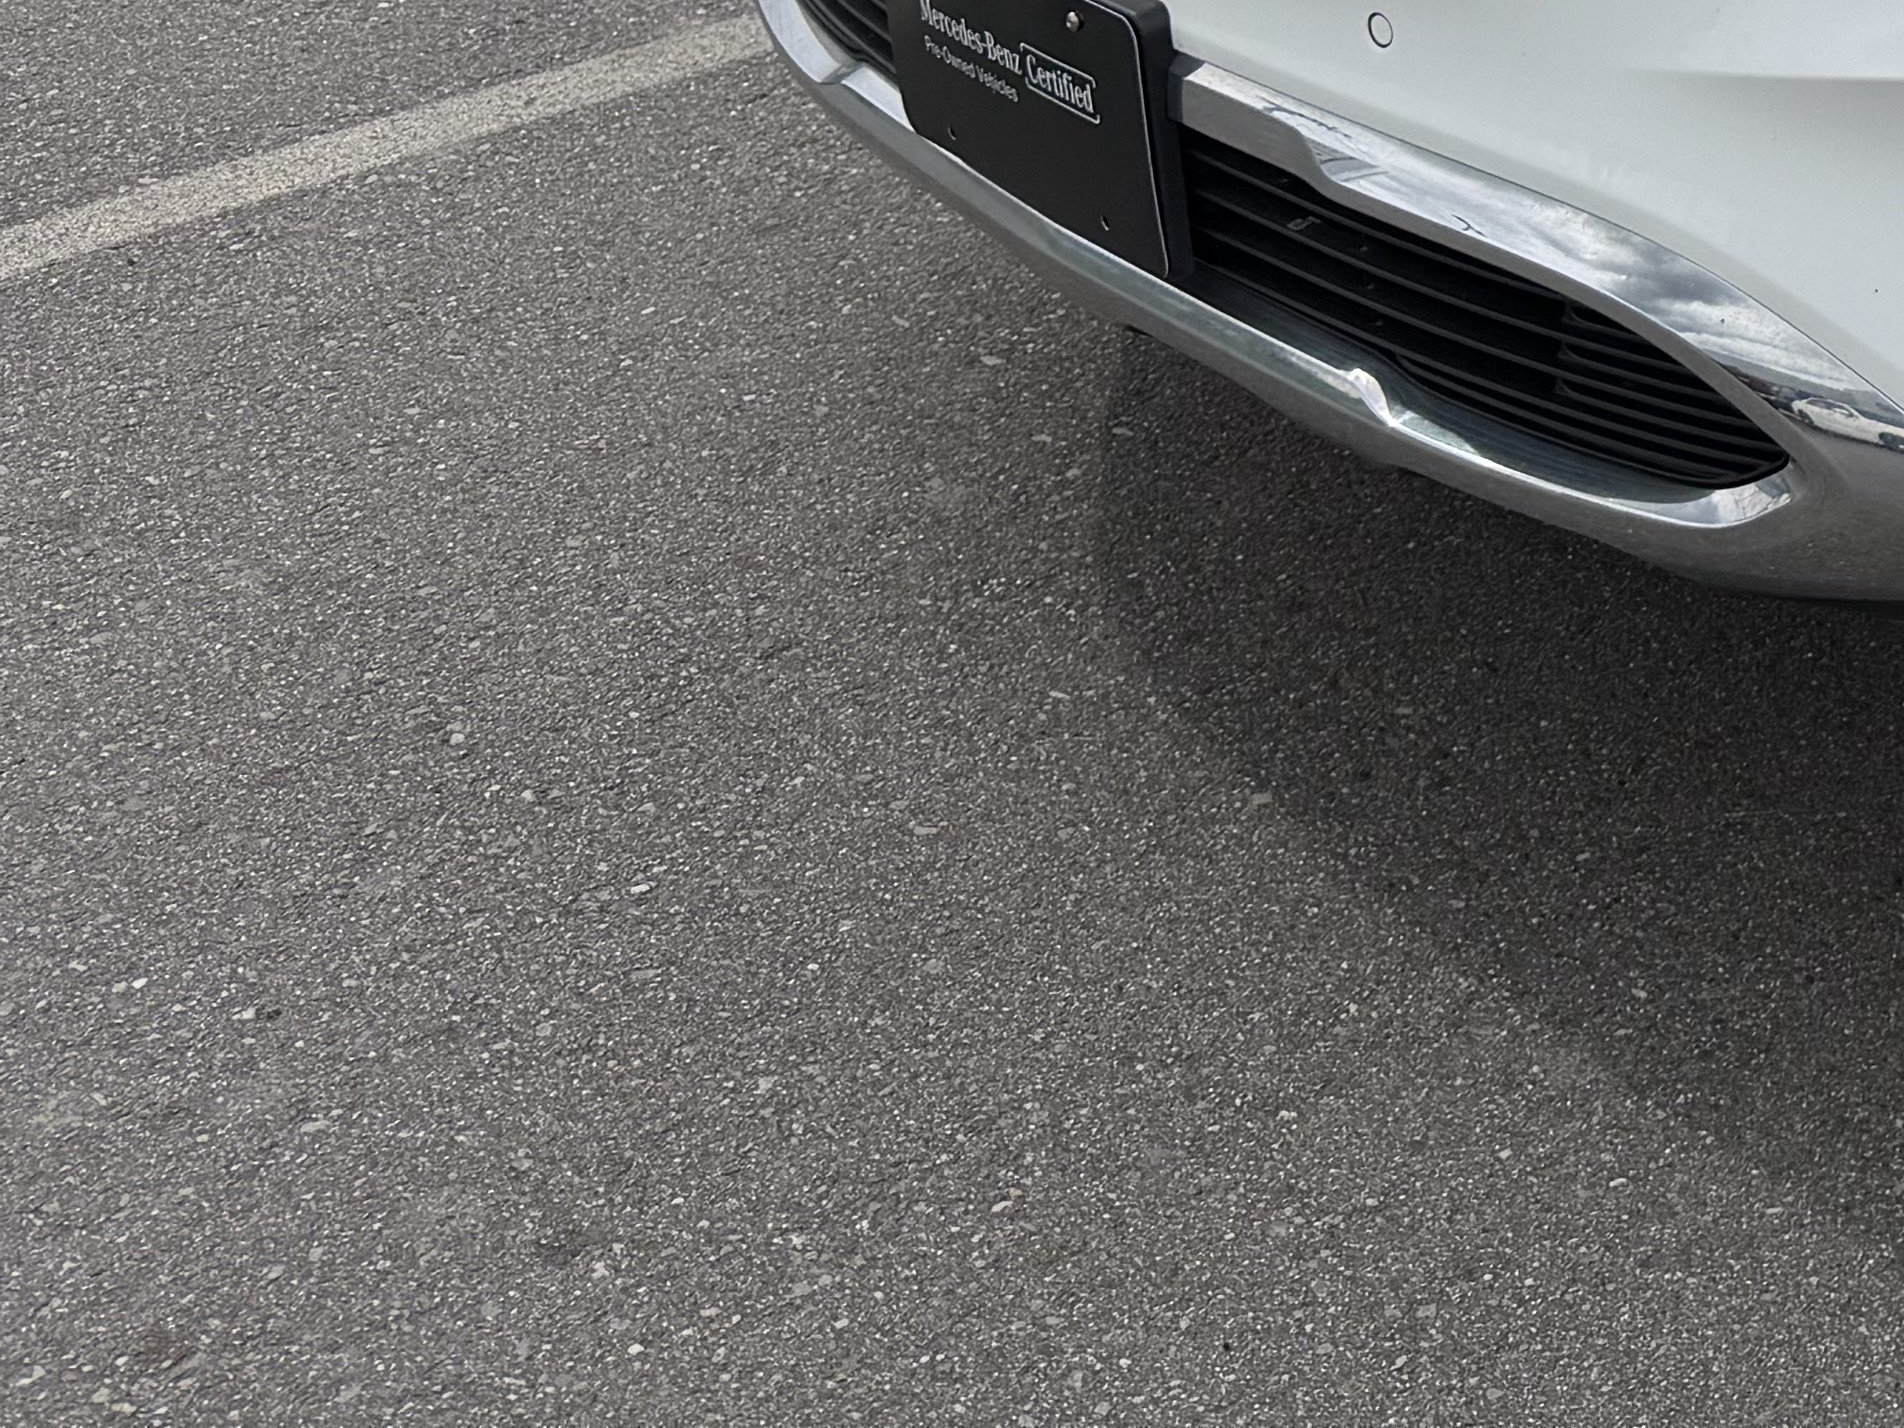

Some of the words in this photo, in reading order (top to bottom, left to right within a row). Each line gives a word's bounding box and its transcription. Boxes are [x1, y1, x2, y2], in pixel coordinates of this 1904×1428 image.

[924, 34, 976, 79] Pre-Owned
[976, 65, 1019, 102] Vehicles
[1026, 55, 1094, 113] Certified
